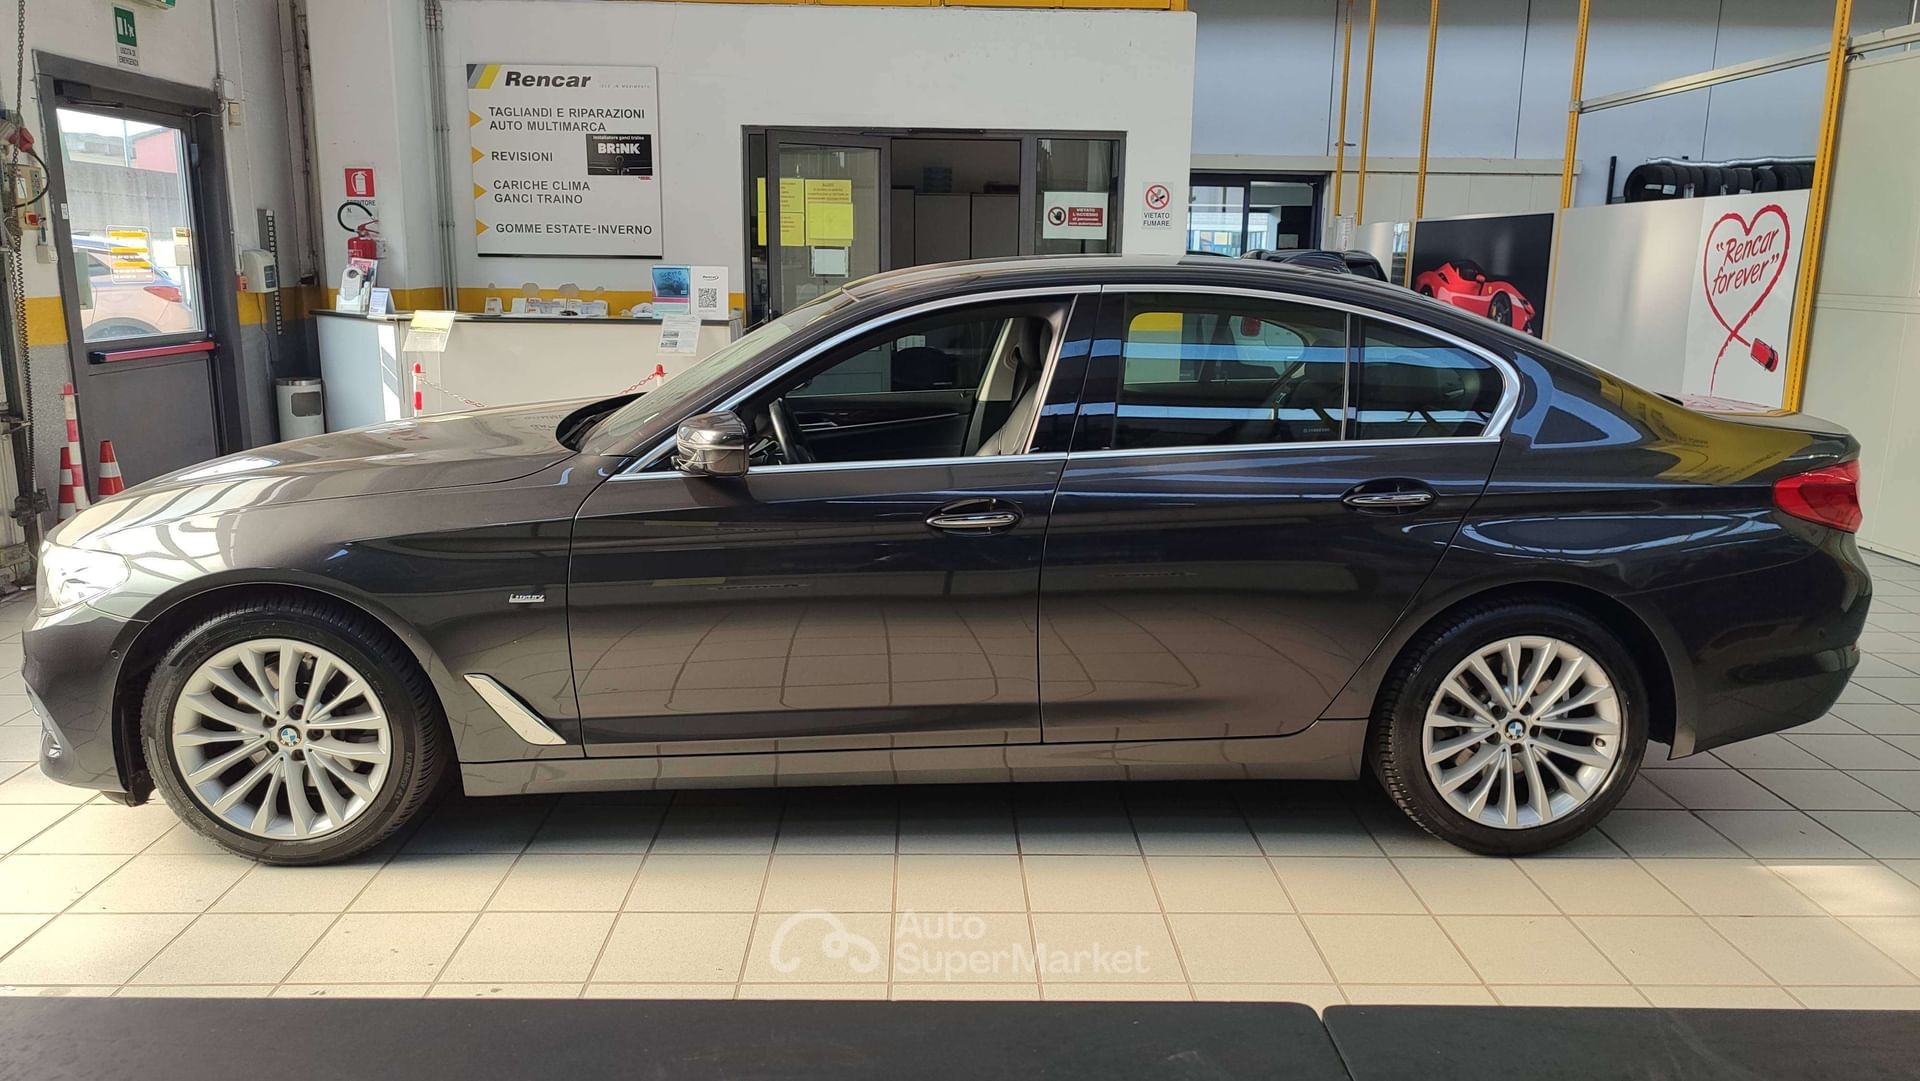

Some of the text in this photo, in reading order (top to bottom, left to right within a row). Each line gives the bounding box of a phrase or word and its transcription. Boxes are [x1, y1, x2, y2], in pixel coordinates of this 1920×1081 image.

[505, 71, 592, 88] Rencar
[489, 107, 645, 119] TAGLIANDI E RIPARAZIONI
[489, 121, 607, 132] AUTO MULTIMARCA
[491, 151, 553, 162] REVISIONI
[493, 180, 591, 191] CARICHE CLIMA
[494, 193, 583, 204] GANCI TRAINO
[496, 223, 652, 235] GOMME ESTATE-INVERNO
